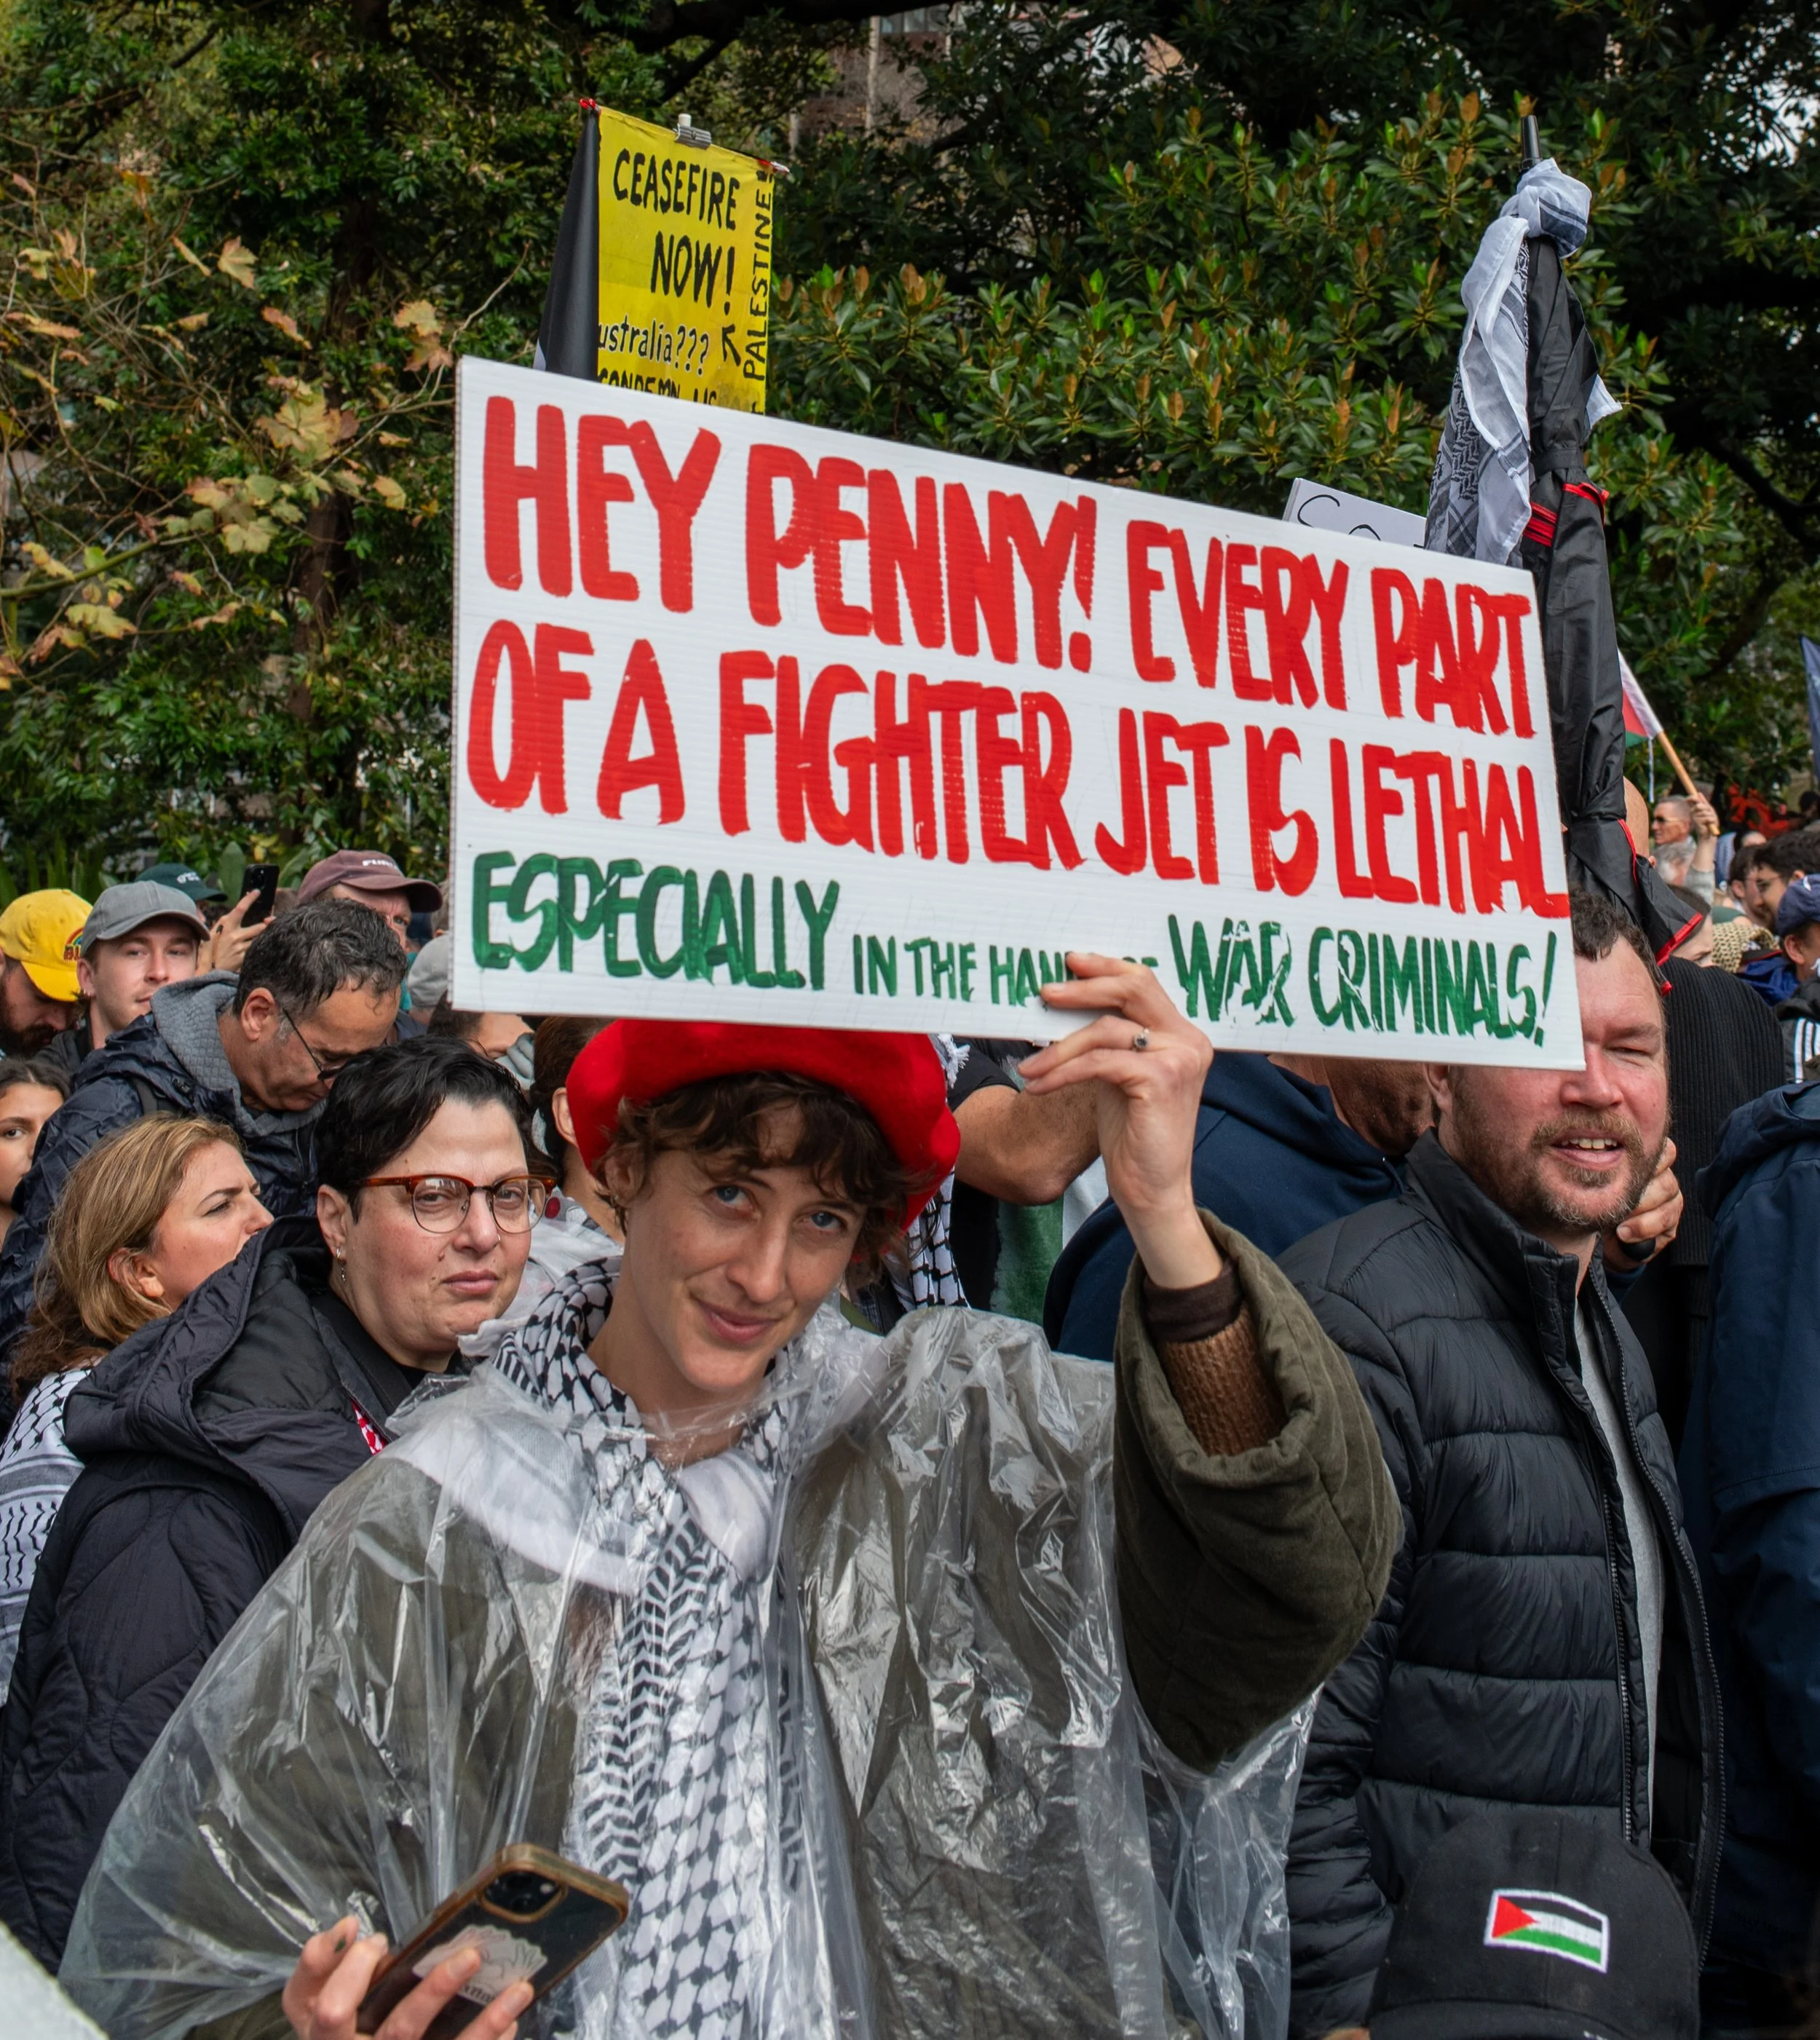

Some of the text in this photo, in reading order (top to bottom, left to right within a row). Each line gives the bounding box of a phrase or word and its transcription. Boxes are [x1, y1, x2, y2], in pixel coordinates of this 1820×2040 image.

[613, 148, 740, 231] CEASEFIRE
[650, 230, 735, 316] NOW!
[483, 395, 1538, 739] HEY PENNY! EVERY PART
[467, 620, 1572, 919] OF A FIGHTER JET IS LETHAL
[472, 850, 840, 991] ESPECIALLY
[853, 934, 897, 997] IN
[904, 936, 977, 1002] THE
[1168, 914, 1296, 1028] WAR
[1308, 925, 1557, 1048] CRIMINALS!
